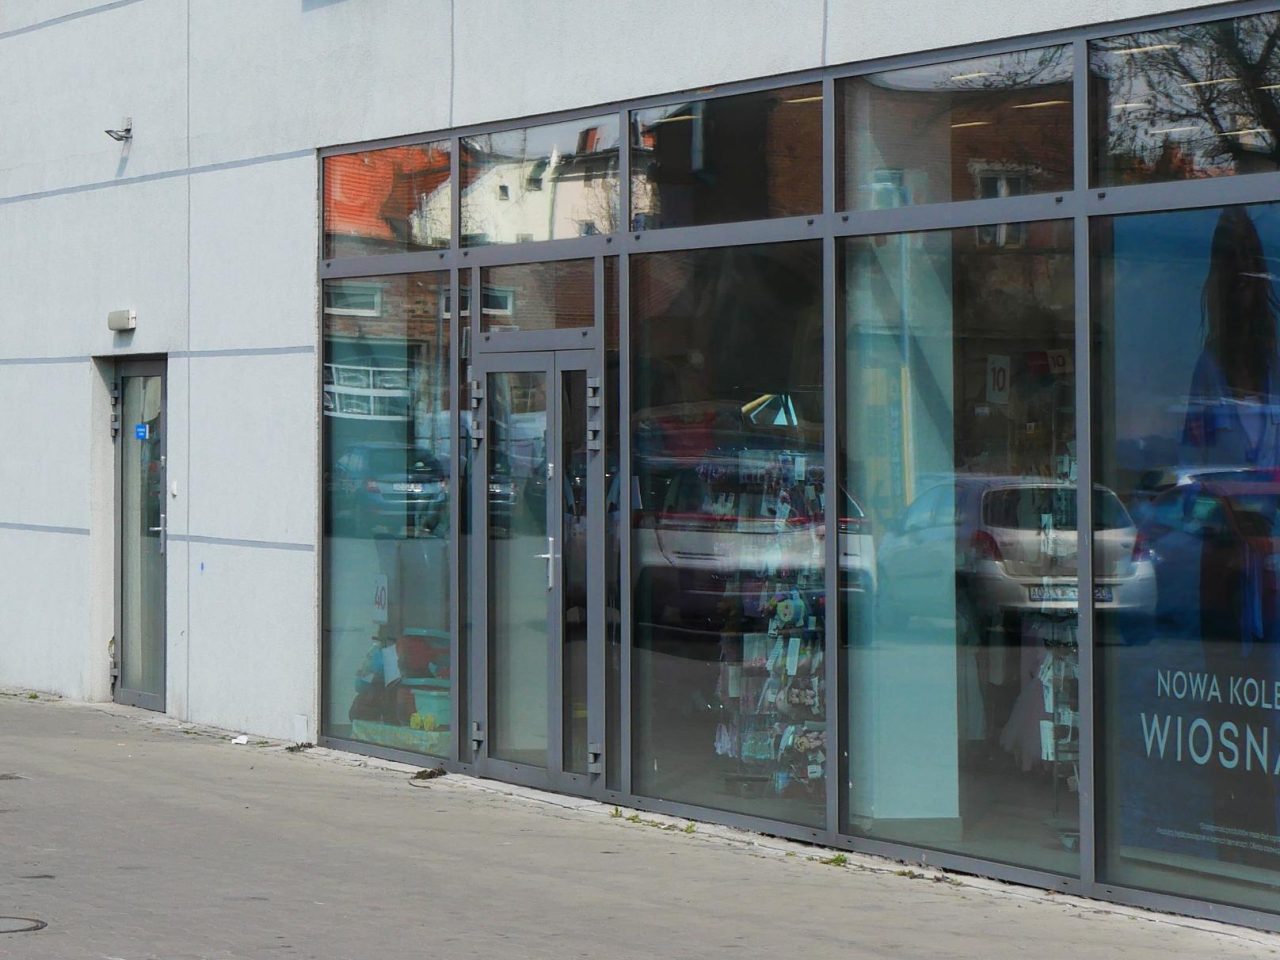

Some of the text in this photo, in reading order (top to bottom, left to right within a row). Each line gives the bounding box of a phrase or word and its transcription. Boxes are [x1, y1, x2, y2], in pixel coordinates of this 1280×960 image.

[992, 366, 1006, 392] 10
[1157, 668, 1222, 703] NOWA
[1140, 712, 1280, 775] WIOSN
